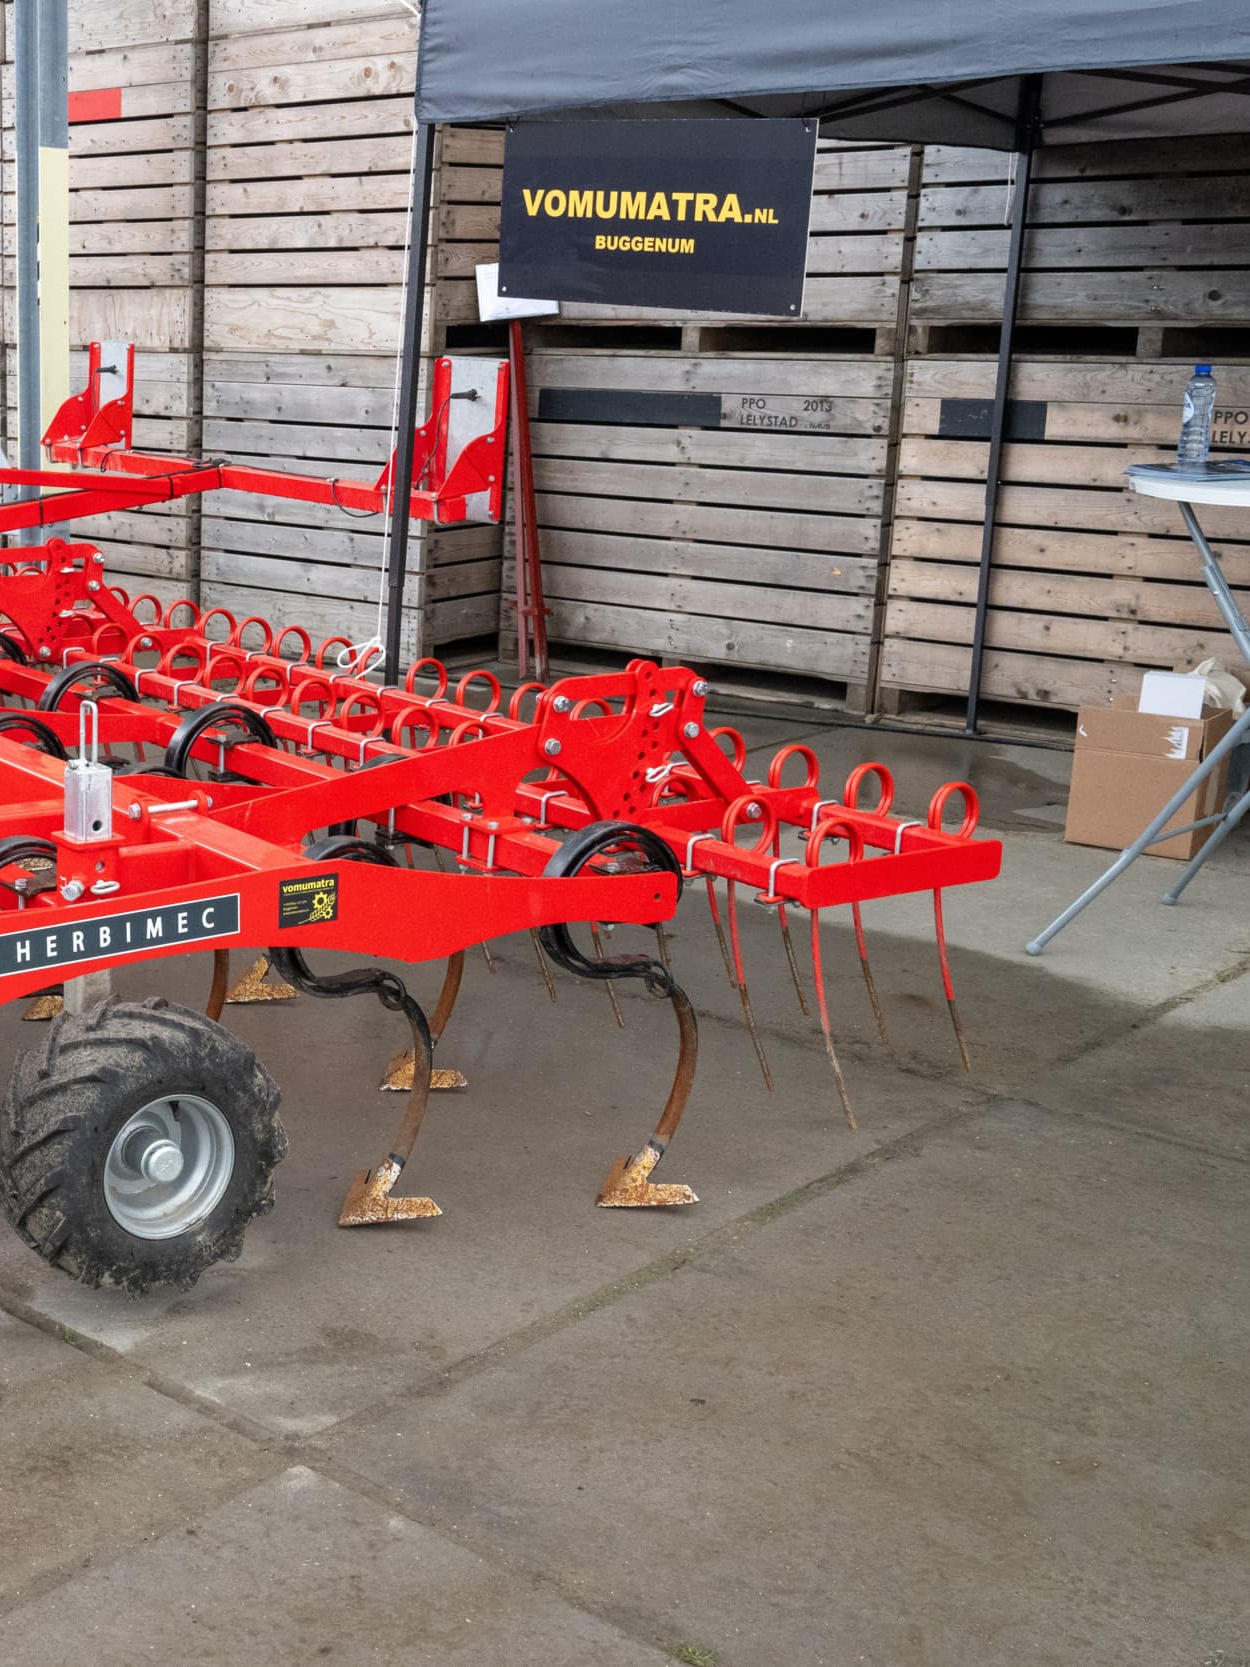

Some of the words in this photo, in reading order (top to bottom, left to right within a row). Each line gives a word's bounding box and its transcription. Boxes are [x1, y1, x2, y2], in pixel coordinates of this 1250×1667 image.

[522, 189, 779, 224] VOMUMATRA.NL
[595, 235, 695, 254] BUGGENUM
[741, 398, 766, 409] PPO
[803, 400, 833, 412] 2013
[740, 414, 798, 428] LELYSTAD
[1214, 411, 1248, 425] PPO
[1212, 430, 1250, 444] LELY
[282, 879, 335, 893] vomumatra
[16, 907, 215, 963] HERBIMEC
